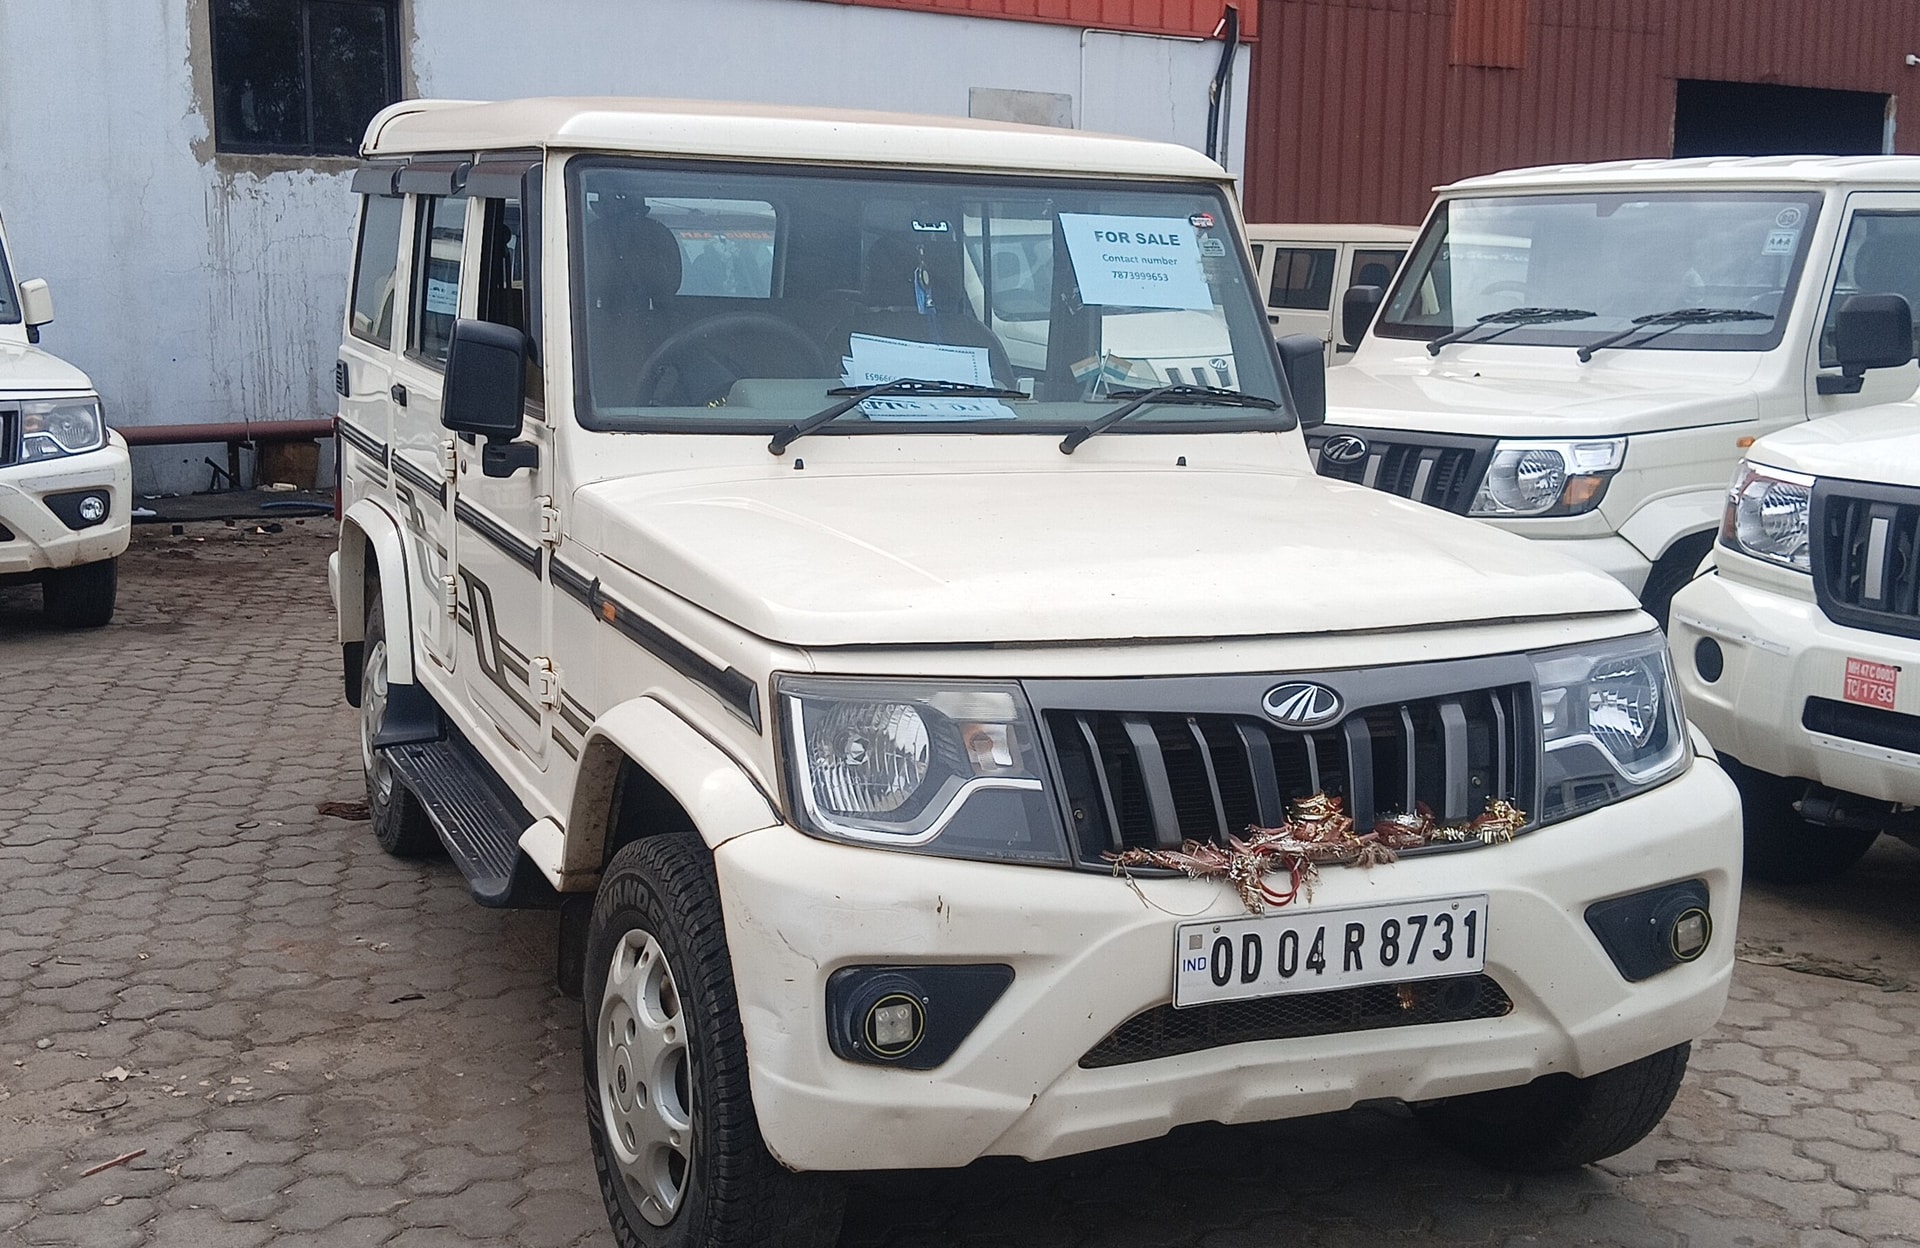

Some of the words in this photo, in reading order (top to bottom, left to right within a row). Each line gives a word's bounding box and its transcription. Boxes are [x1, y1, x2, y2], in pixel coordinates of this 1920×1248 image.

[1094, 230, 1131, 244] FOR
[1135, 232, 1181, 246] SALE
[1102, 253, 1139, 263] Contact
[1141, 256, 1177, 266] number
[1111, 270, 1169, 282] 7873999653
[1211, 933, 1263, 987] OD
[1277, 926, 1326, 978] 04
[1343, 922, 1365, 972] R
[1379, 910, 1477, 967] 8731
[1182, 956, 1207, 973] IND
